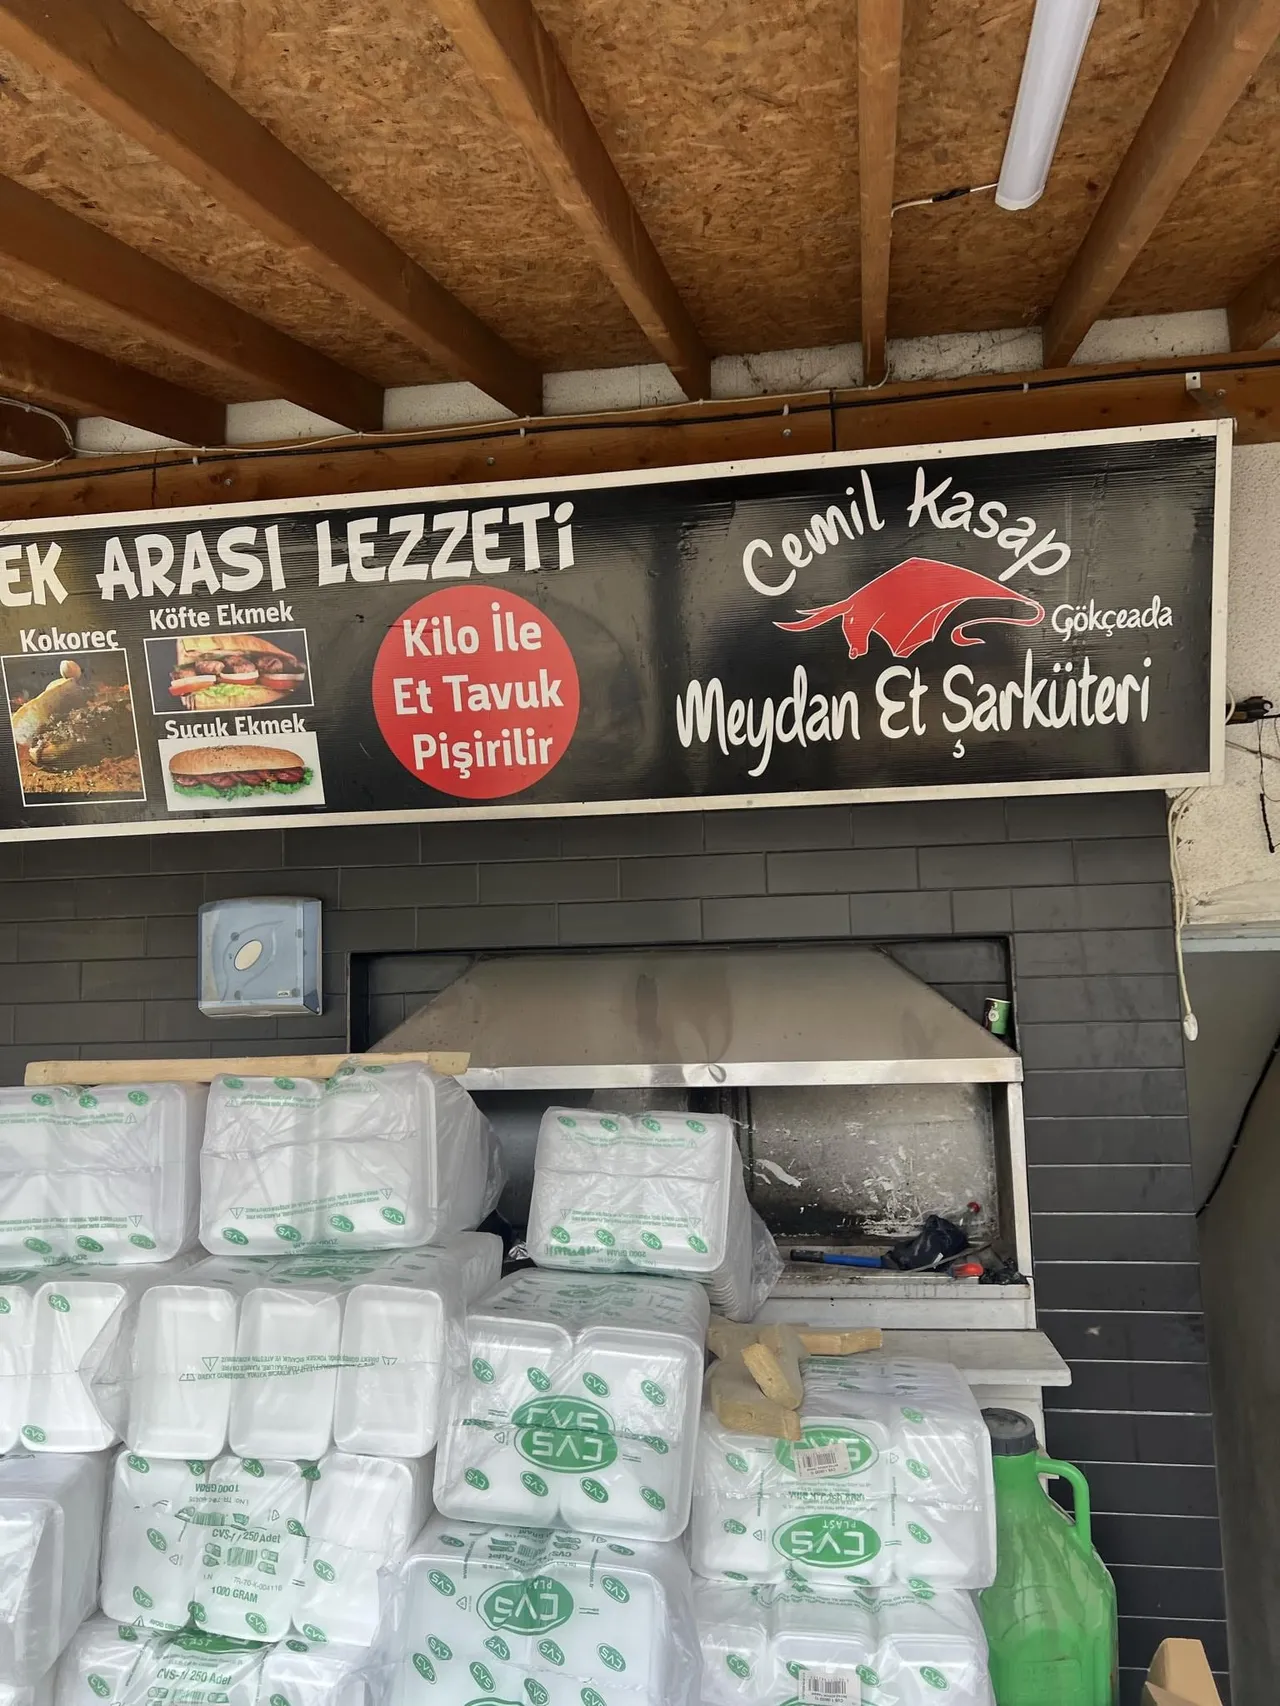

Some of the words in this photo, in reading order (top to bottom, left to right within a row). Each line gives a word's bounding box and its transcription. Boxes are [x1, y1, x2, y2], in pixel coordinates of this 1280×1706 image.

[742, 468, 886, 597] Cemil
[907, 466, 1072, 583] Kasap
[95, 523, 287, 602] ARASI
[149, 607, 210, 631] Köfte
[216, 600, 294, 626] Ekmek
[1051, 594, 1174, 644] Gökçeada
[18, 624, 120, 653] Kokoreç
[402, 617, 480, 658] Kilo
[490, 601, 543, 653] İle
[392, 676, 433, 716] Et
[440, 673, 565, 713] Tavuk
[675, 664, 861, 778] Meydan
[874, 666, 930, 740] Et
[942, 648, 1153, 760] Şarküteri
[164, 716, 230, 740] Sucuk
[234, 712, 307, 736] Ekmek
[411, 732, 554, 780] Pişirilir
[473, 1358, 494, 1383] CVS
[528, 1367, 550, 1391] CVS
[585, 1373, 608, 1396] CVS
[642, 1380, 665, 1404] CVS
[531, 1430, 604, 1463] CVS
[583, 1478, 606, 1501] CVS
[821, 1519, 857, 1530] PLAST
[242, 1531, 260, 1541] 250
[259, 1533, 281, 1544] Adet
[790, 1531, 865, 1555] CVS
[315, 1561, 334, 1580] CVS
[430, 1571, 453, 1595] CVS
[211, 1585, 231, 1597] 1000
[232, 1589, 259, 1604] GRAM
[532, 1579, 553, 1590] PLA
[604, 1577, 628, 1602] CVS
[493, 1592, 560, 1624] CVS
[539, 1642, 563, 1664] CVS
[600, 1648, 624, 1670] CVS
[189, 1669, 208, 1683] 250
[208, 1672, 232, 1685] Adet
[472, 1663, 493, 1688] CVS
